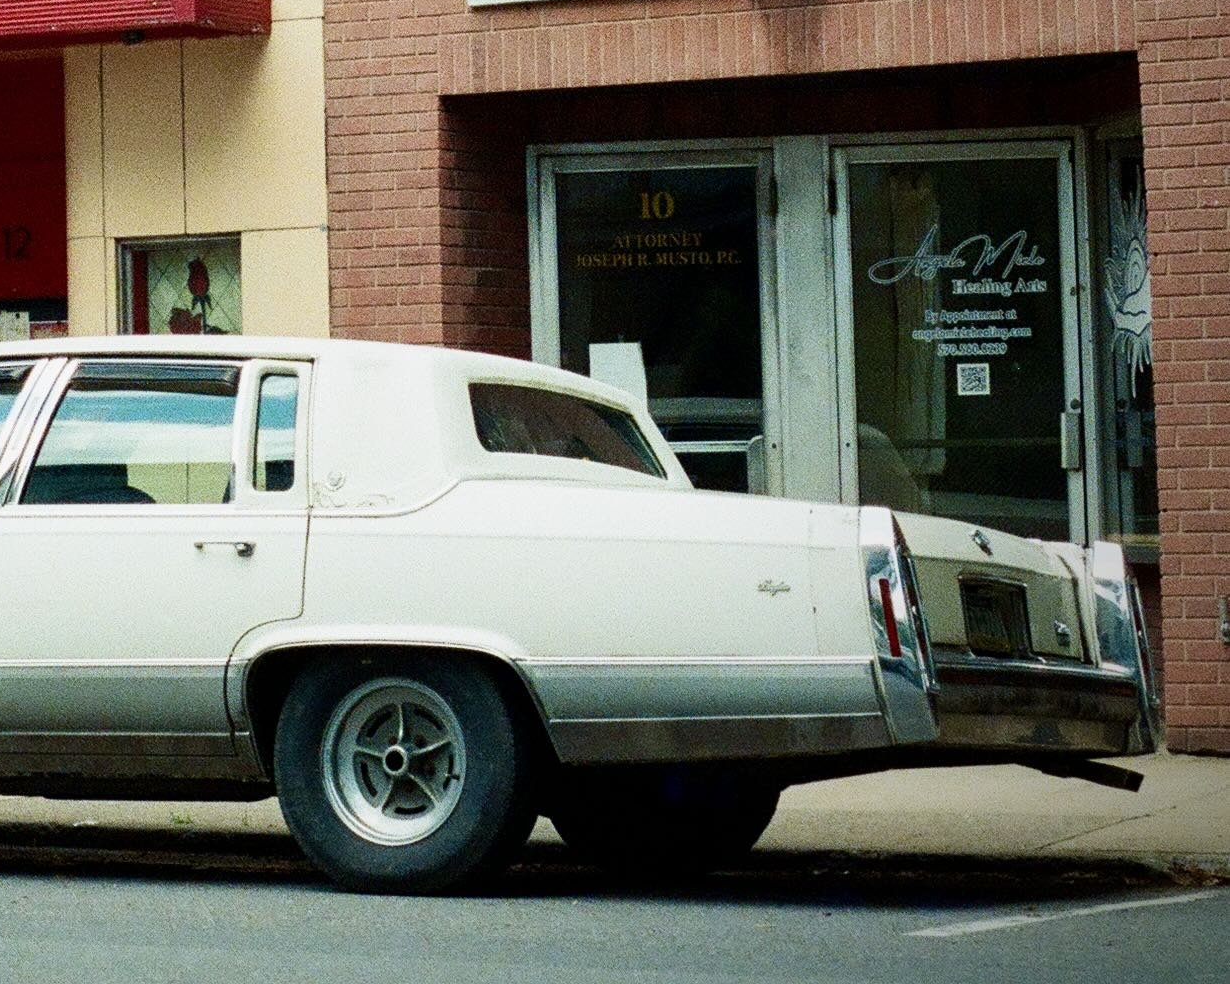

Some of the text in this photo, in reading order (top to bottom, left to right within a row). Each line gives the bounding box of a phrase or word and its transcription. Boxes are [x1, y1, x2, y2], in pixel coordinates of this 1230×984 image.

[639, 190, 675, 220] 10
[4, 227, 31, 259] 12
[613, 233, 703, 249] ATTORNEY
[575, 252, 633, 268] JOSEPH
[951, 277, 1048, 297] Healing Arts
